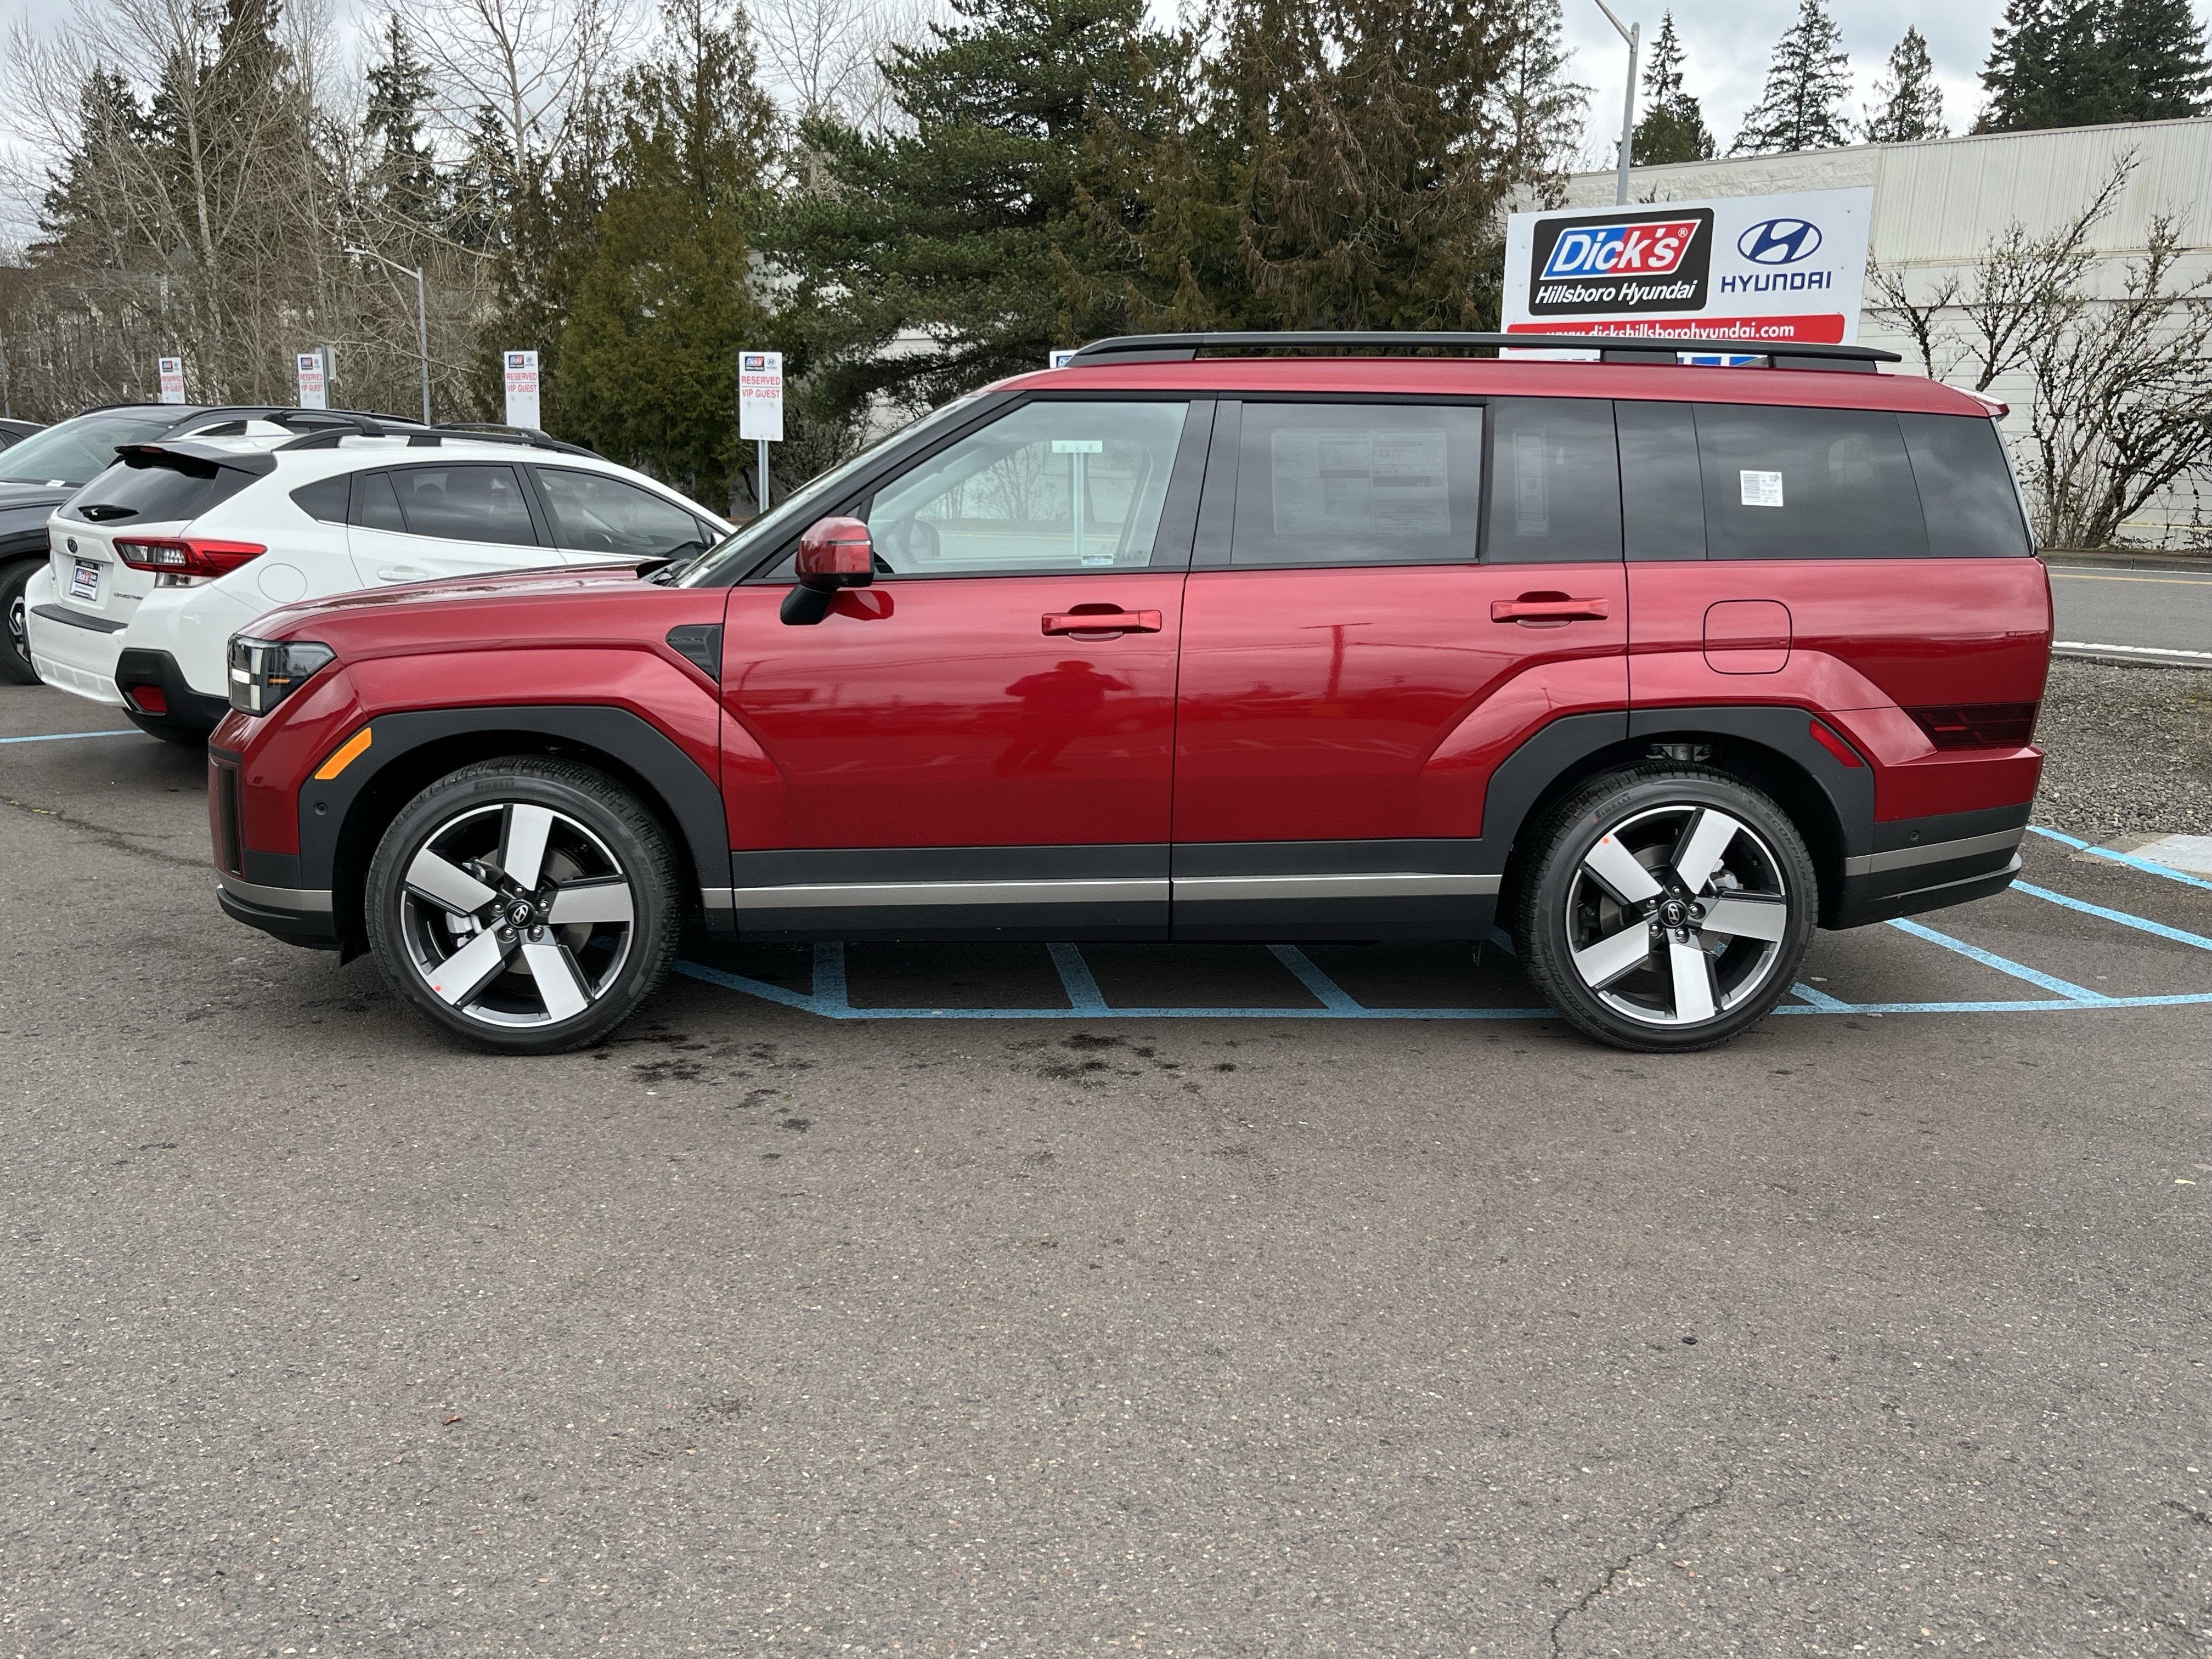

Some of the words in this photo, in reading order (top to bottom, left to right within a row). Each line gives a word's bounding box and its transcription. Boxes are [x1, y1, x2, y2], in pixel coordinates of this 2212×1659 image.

[1720, 271, 1832, 293] HYUNDAI
[1535, 284, 1616, 303] Hillsboro
[1618, 280, 1698, 305] Hyundai
[1546, 321, 1794, 340] dickshillsborohyundai.com
[506, 373, 537, 381] RESERVED
[742, 376, 780, 385] RESERVED
[518, 385, 537, 393] GUEST
[742, 389, 753, 398] VIP
[755, 389, 780, 398] GUEST
[1594, 792, 1631, 819] PIRELLI
[1763, 812, 1807, 881] SCORPION
